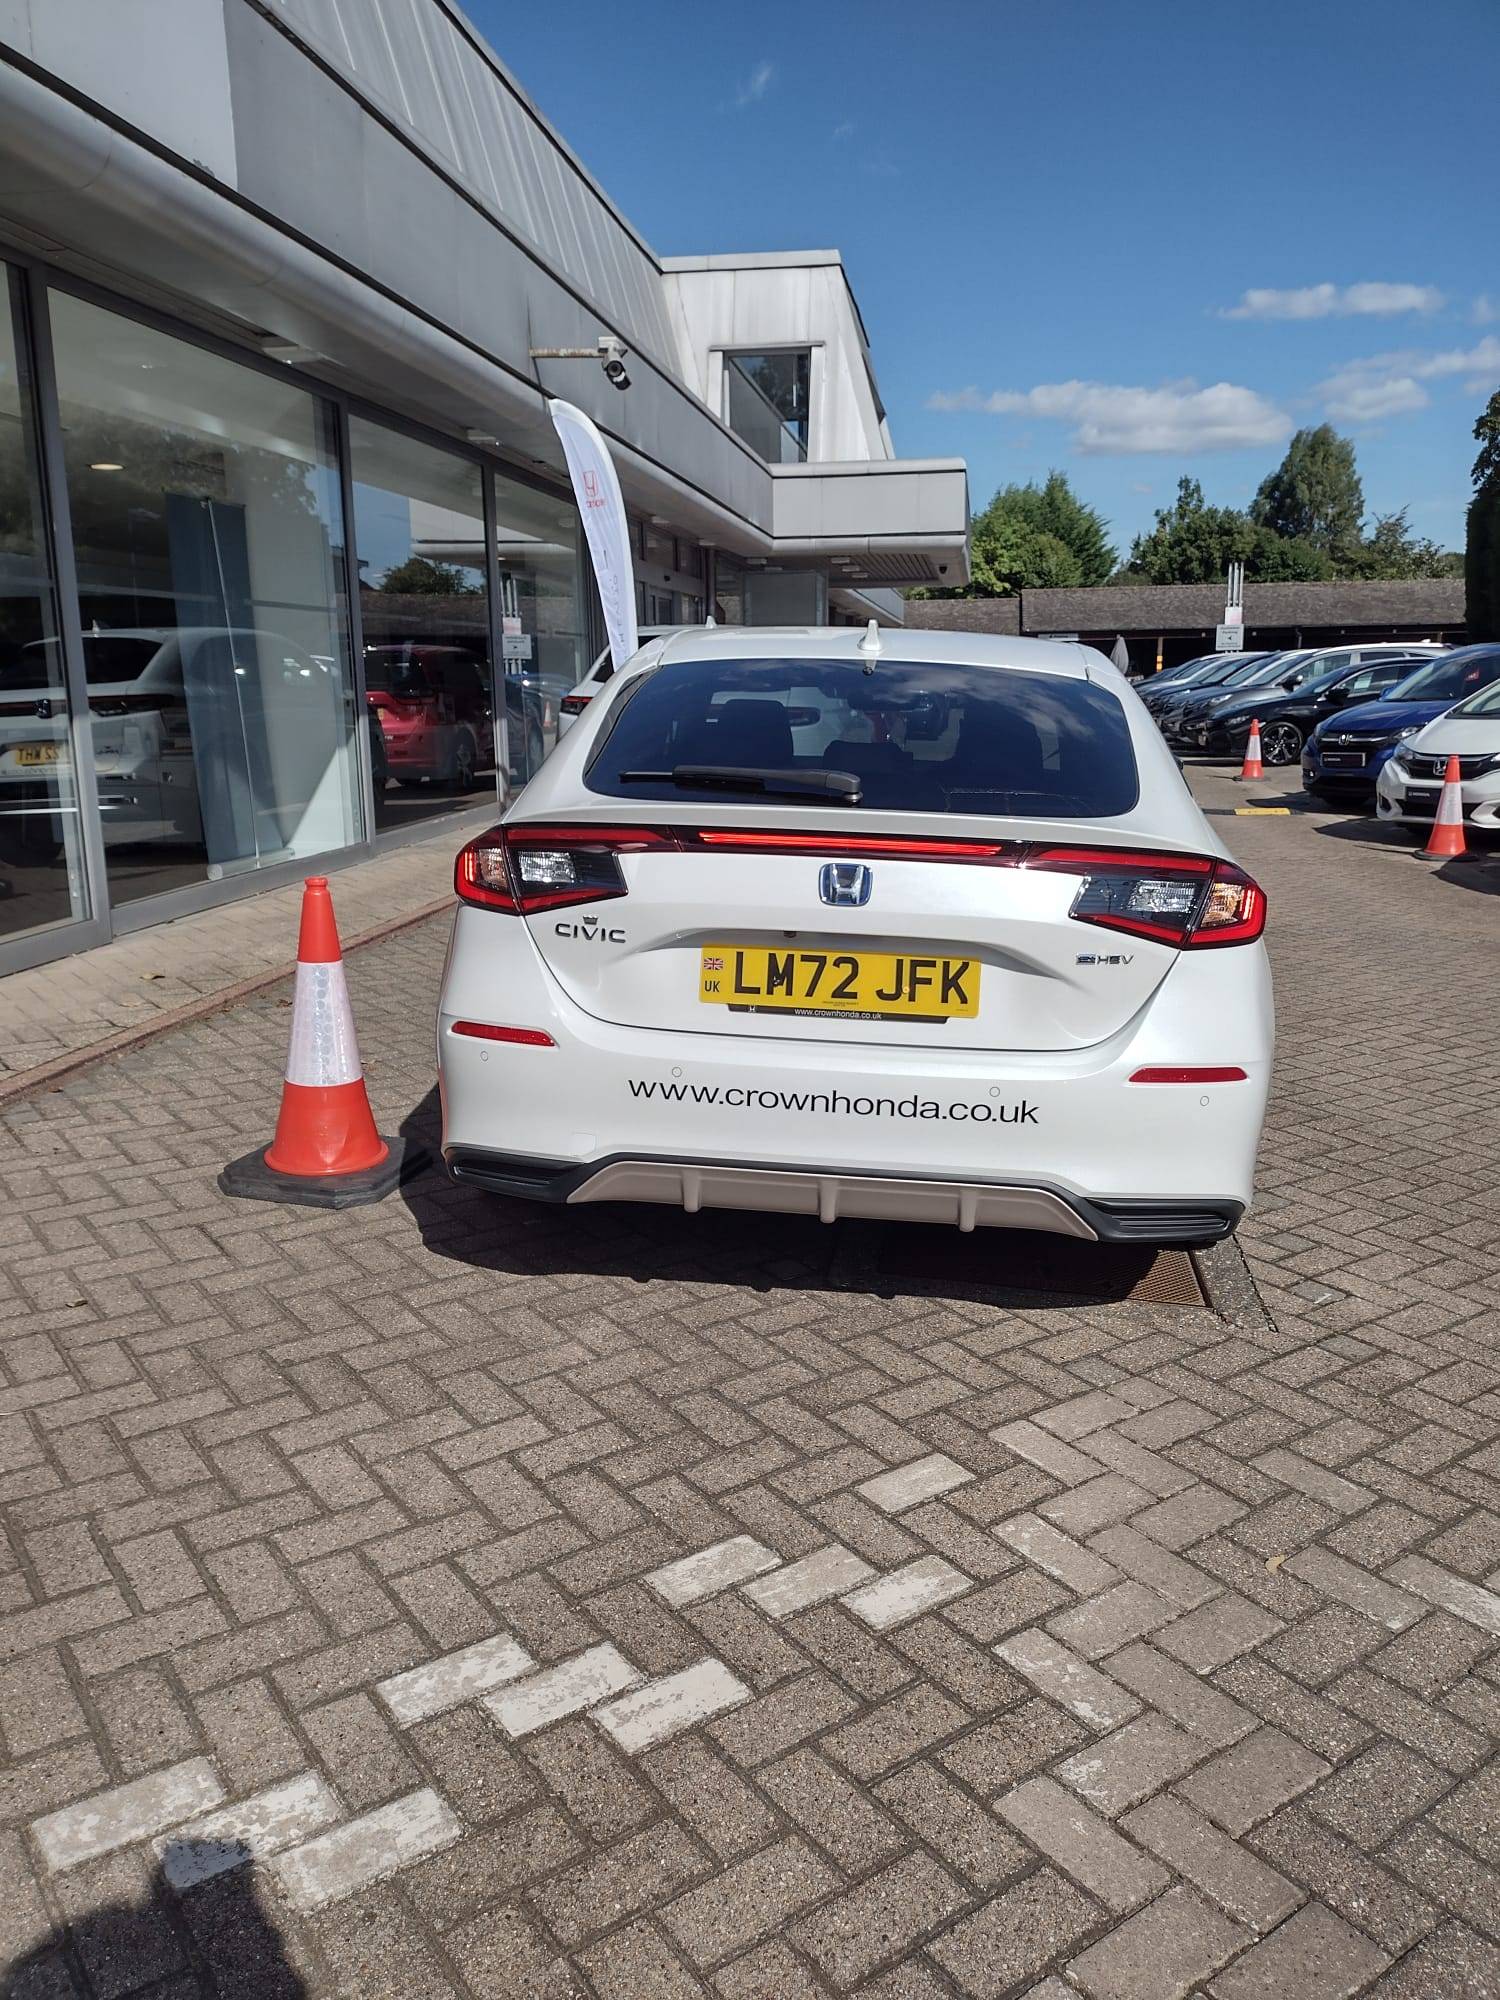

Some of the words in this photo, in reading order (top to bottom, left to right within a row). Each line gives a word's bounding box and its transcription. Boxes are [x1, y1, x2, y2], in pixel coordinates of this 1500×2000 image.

[555, 923, 626, 943] CIVIC
[704, 980, 720, 993] UK
[734, 951, 859, 999] LM72
[875, 957, 970, 1004] JFK
[794, 1007, 882, 1020] www.crownhonda.co.uk
[628, 1078, 1040, 1125] www.crownhonda.co.uk
